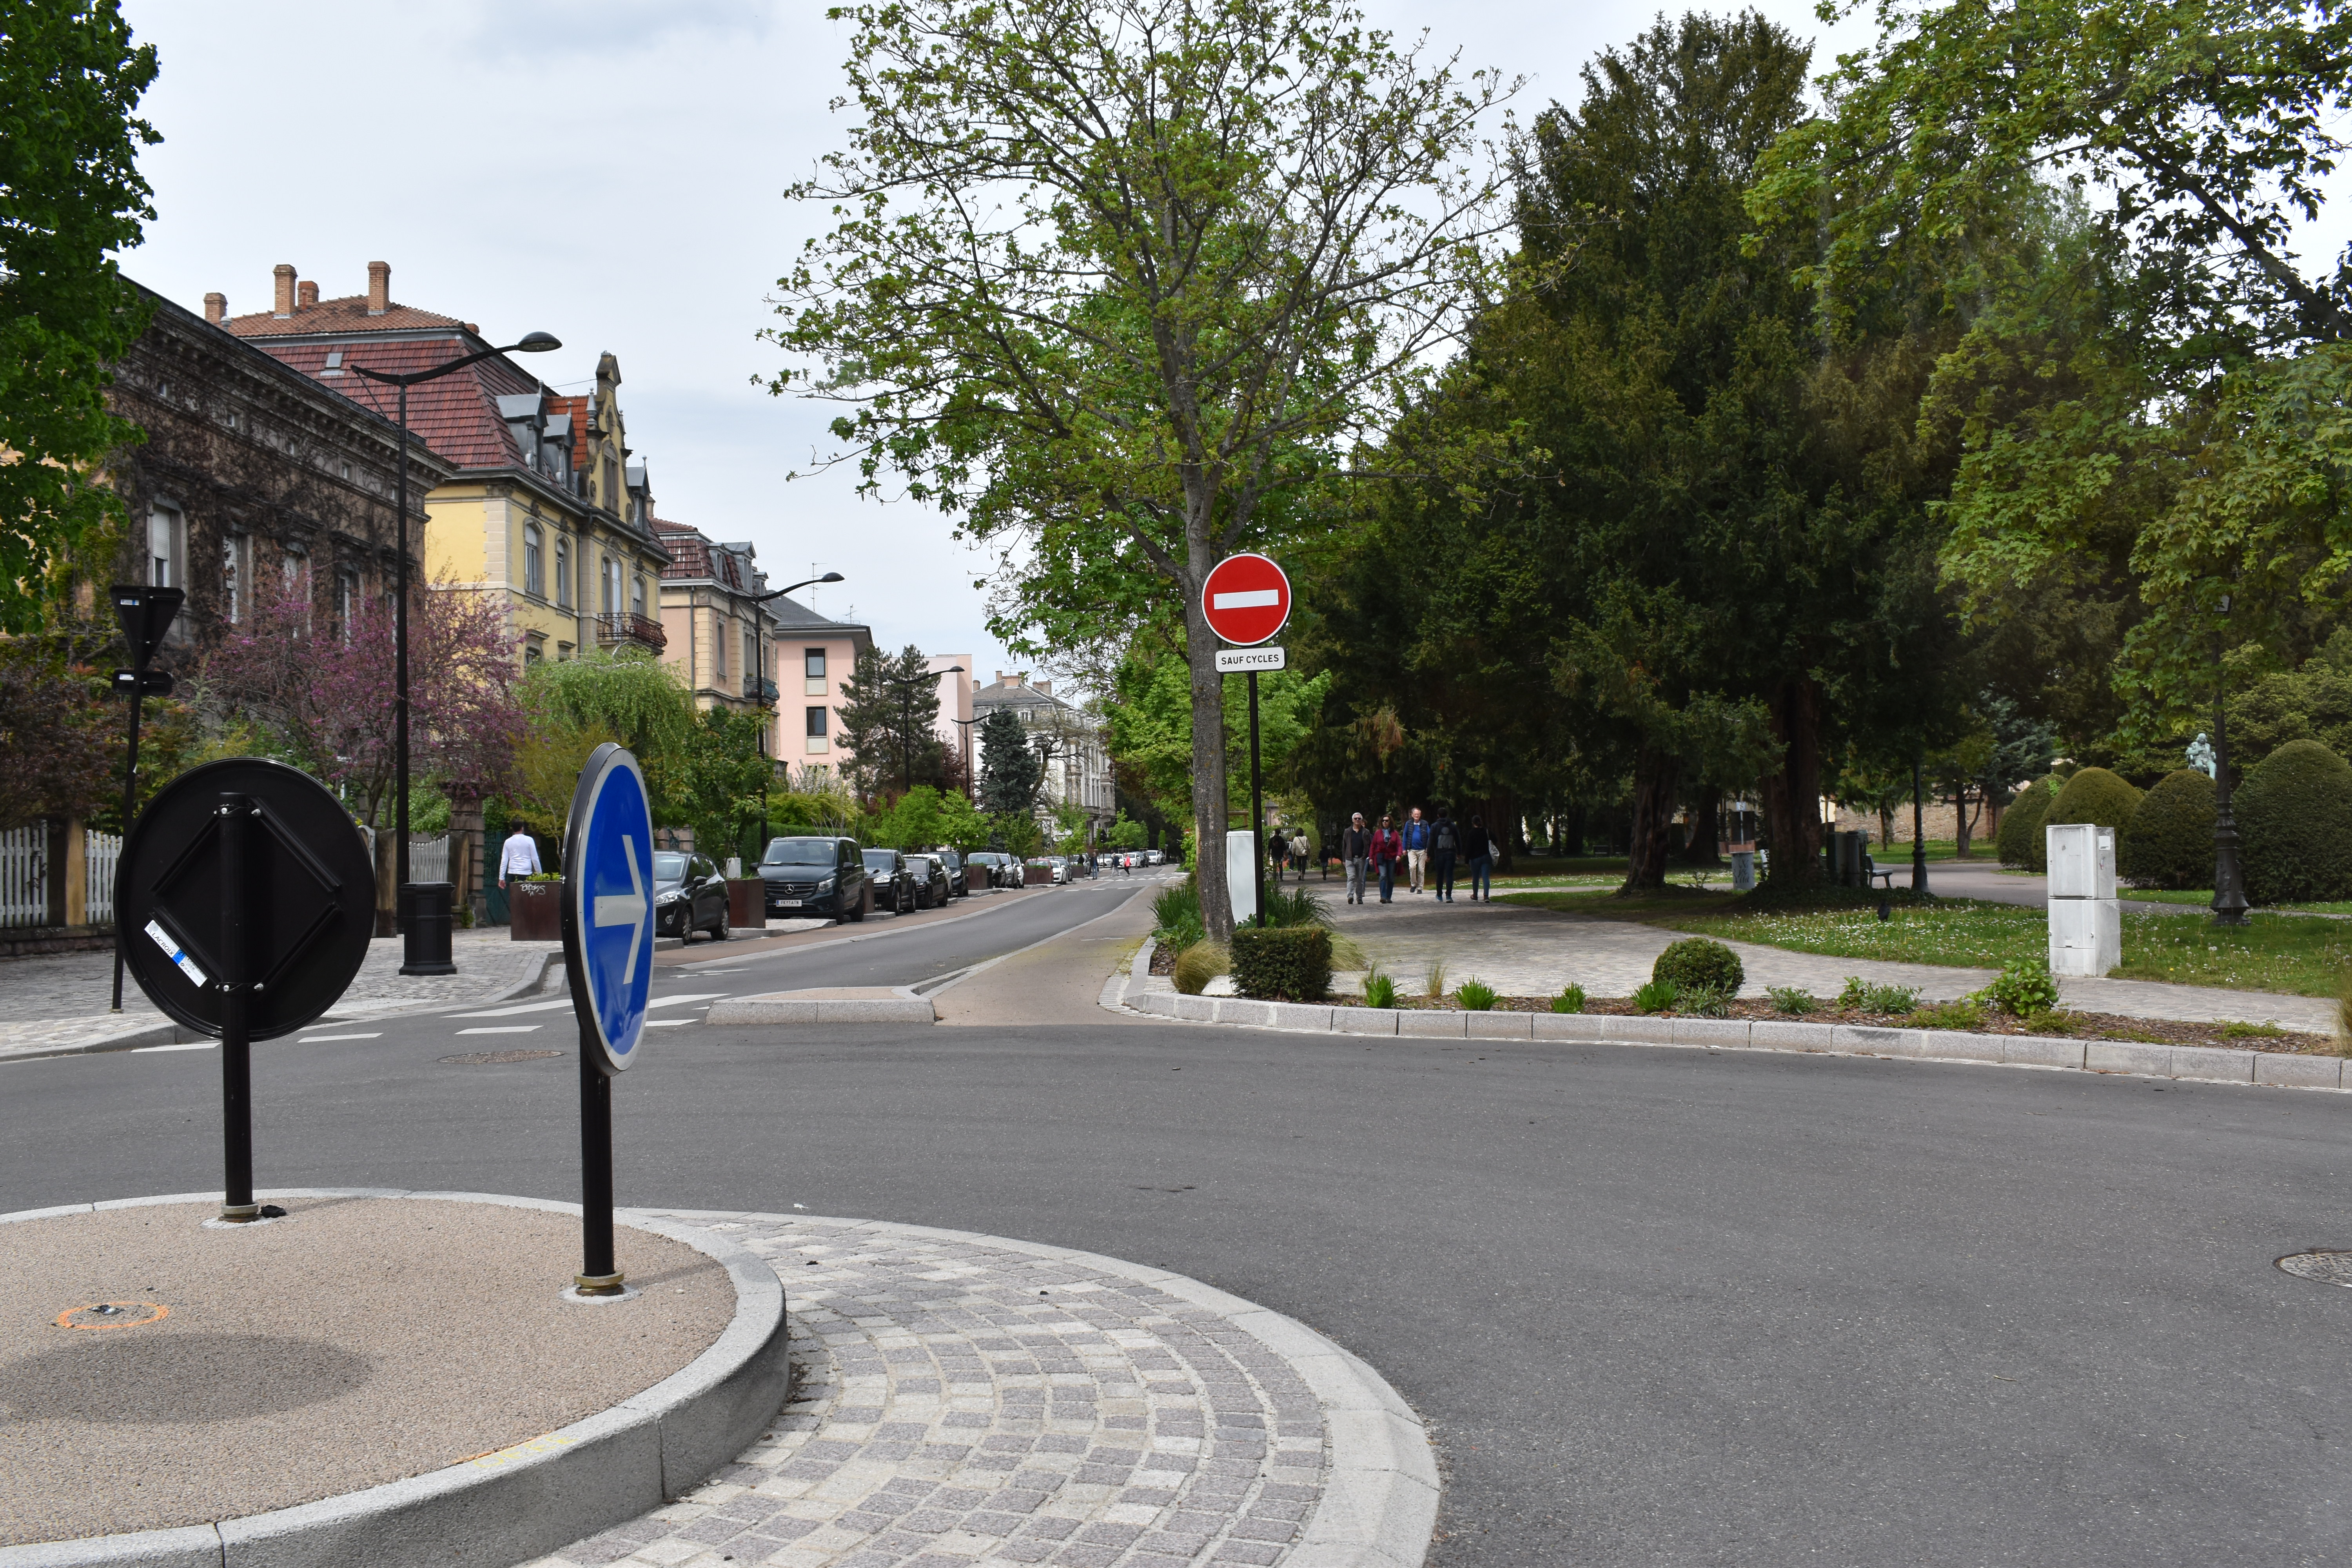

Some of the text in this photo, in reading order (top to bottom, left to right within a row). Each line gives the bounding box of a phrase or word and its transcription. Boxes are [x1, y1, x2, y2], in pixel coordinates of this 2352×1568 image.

[1221, 654, 1279, 665] SAUF CYCLES
[152, 933, 174, 956] LACROIX
